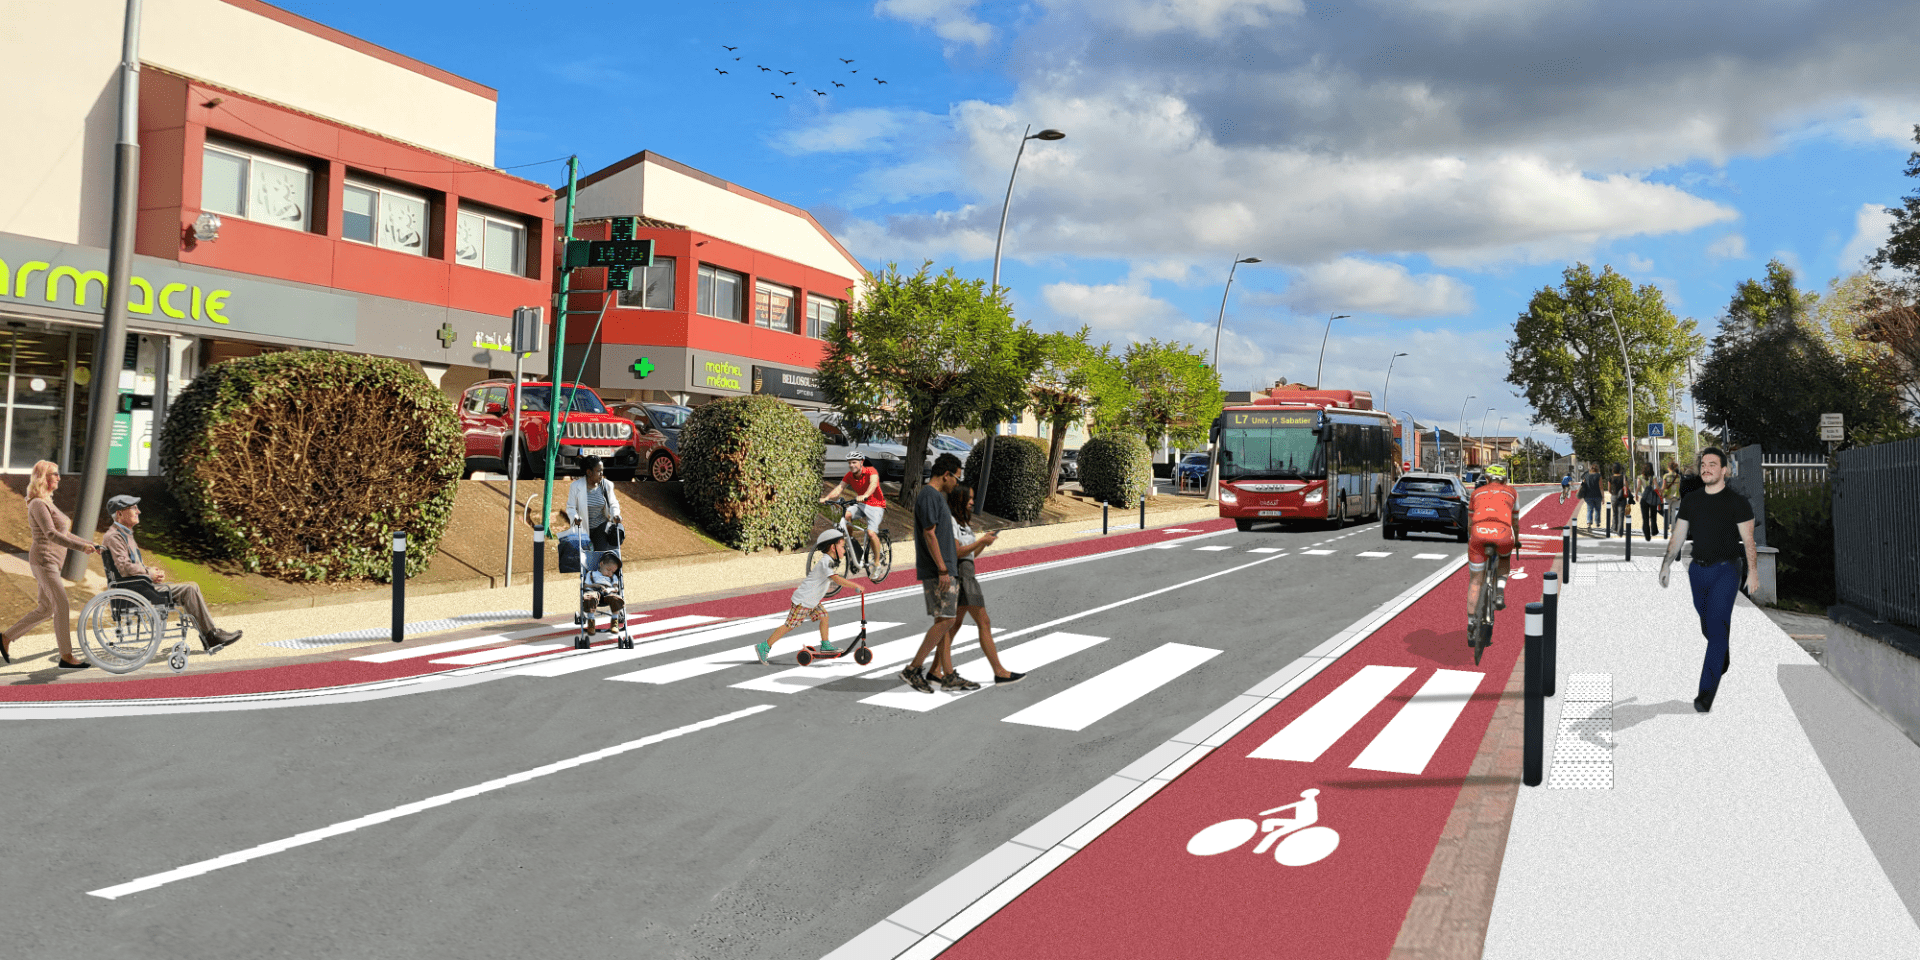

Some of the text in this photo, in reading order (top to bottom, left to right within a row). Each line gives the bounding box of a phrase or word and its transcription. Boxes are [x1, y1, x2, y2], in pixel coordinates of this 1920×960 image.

[1235, 414, 1249, 424] L7
[1251, 416, 1270, 424] Univ.
[1280, 416, 1311, 424] Sabatier
